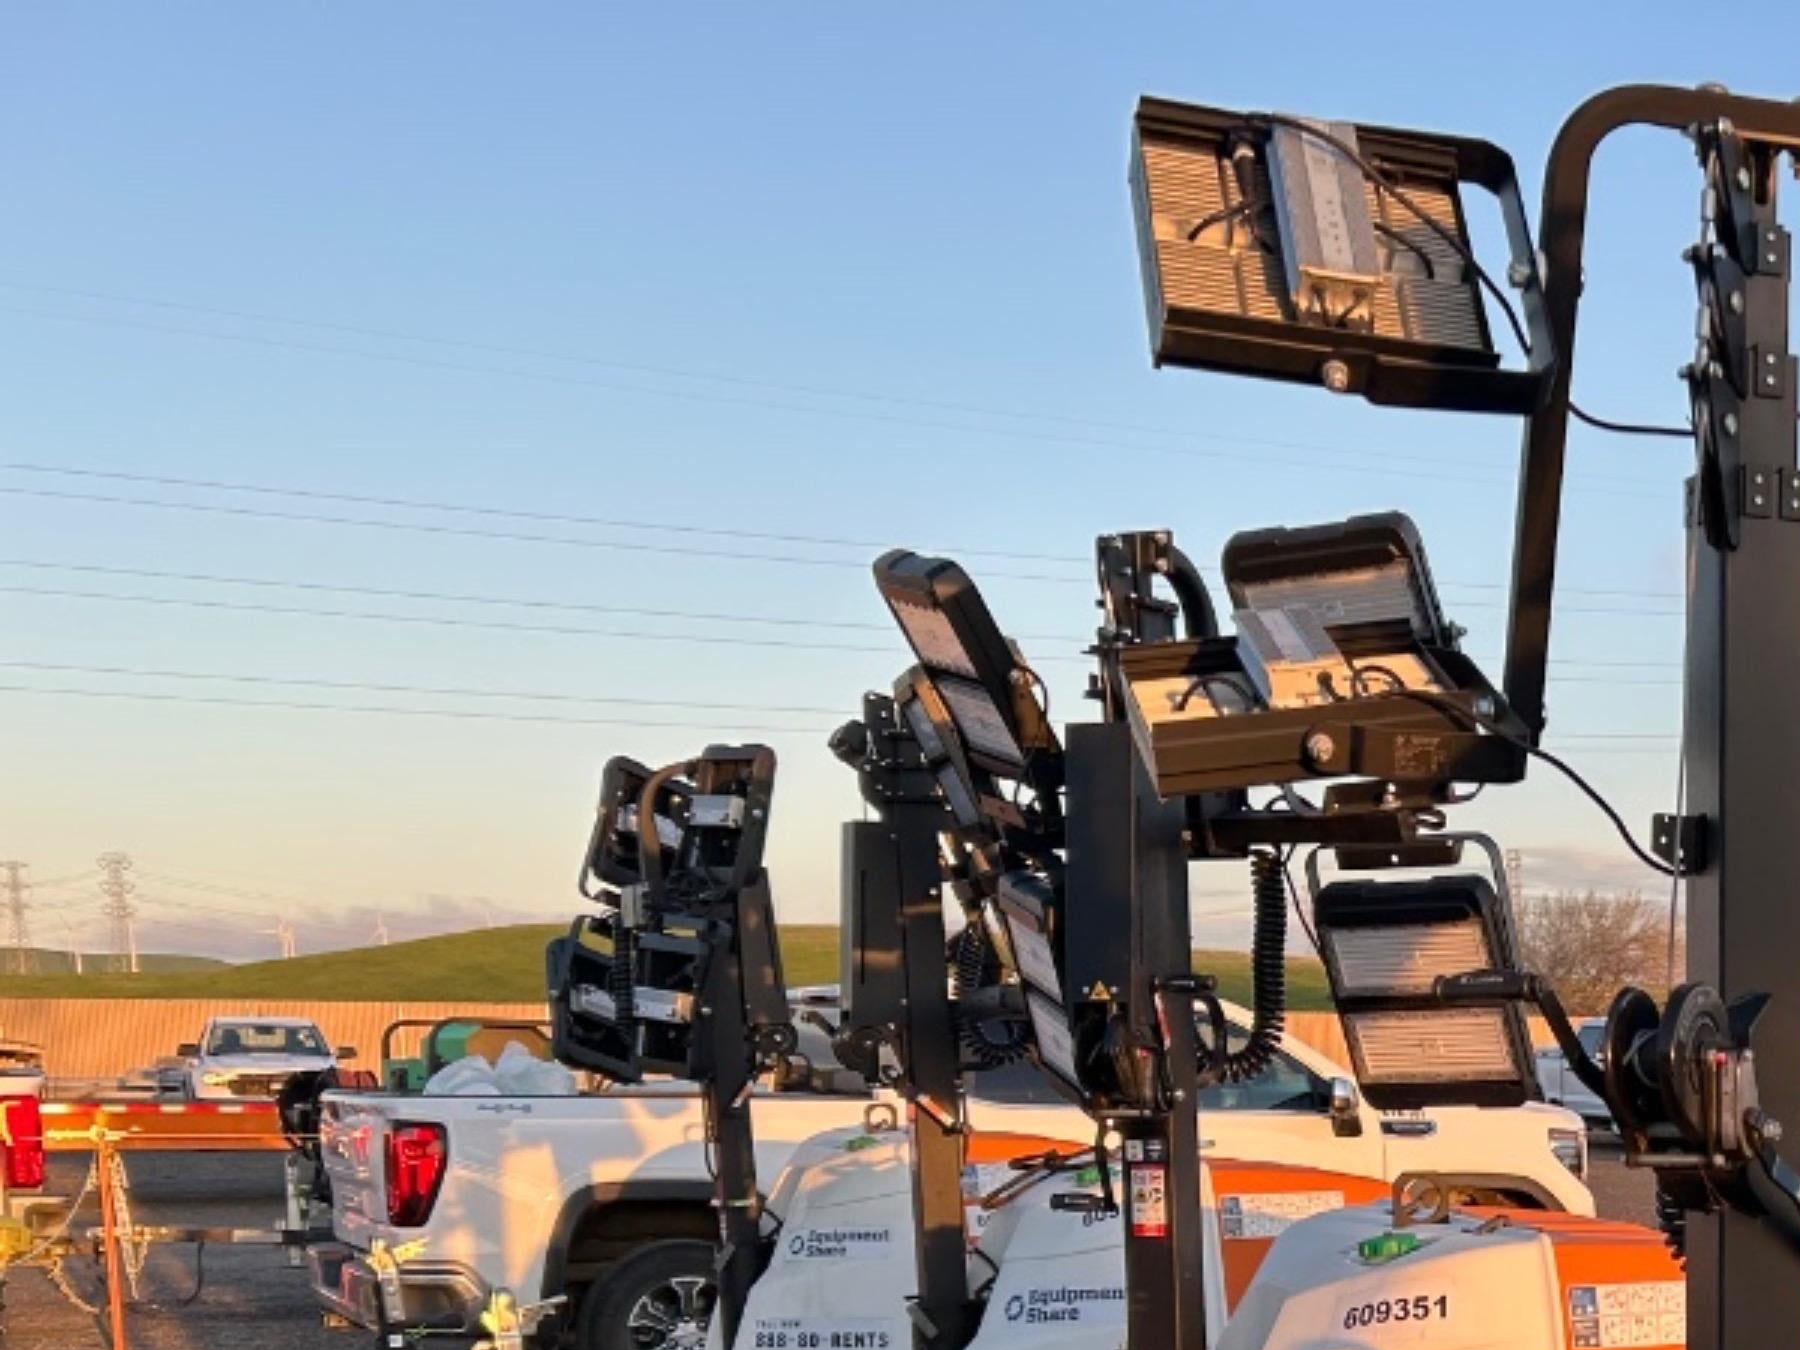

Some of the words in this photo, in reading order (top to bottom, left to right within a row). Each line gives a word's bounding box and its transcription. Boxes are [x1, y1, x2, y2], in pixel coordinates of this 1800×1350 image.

[1028, 1286, 1125, 1306] Equipmen
[1026, 1306, 1081, 1324] Share
[1343, 1295, 1447, 1329] 609351
